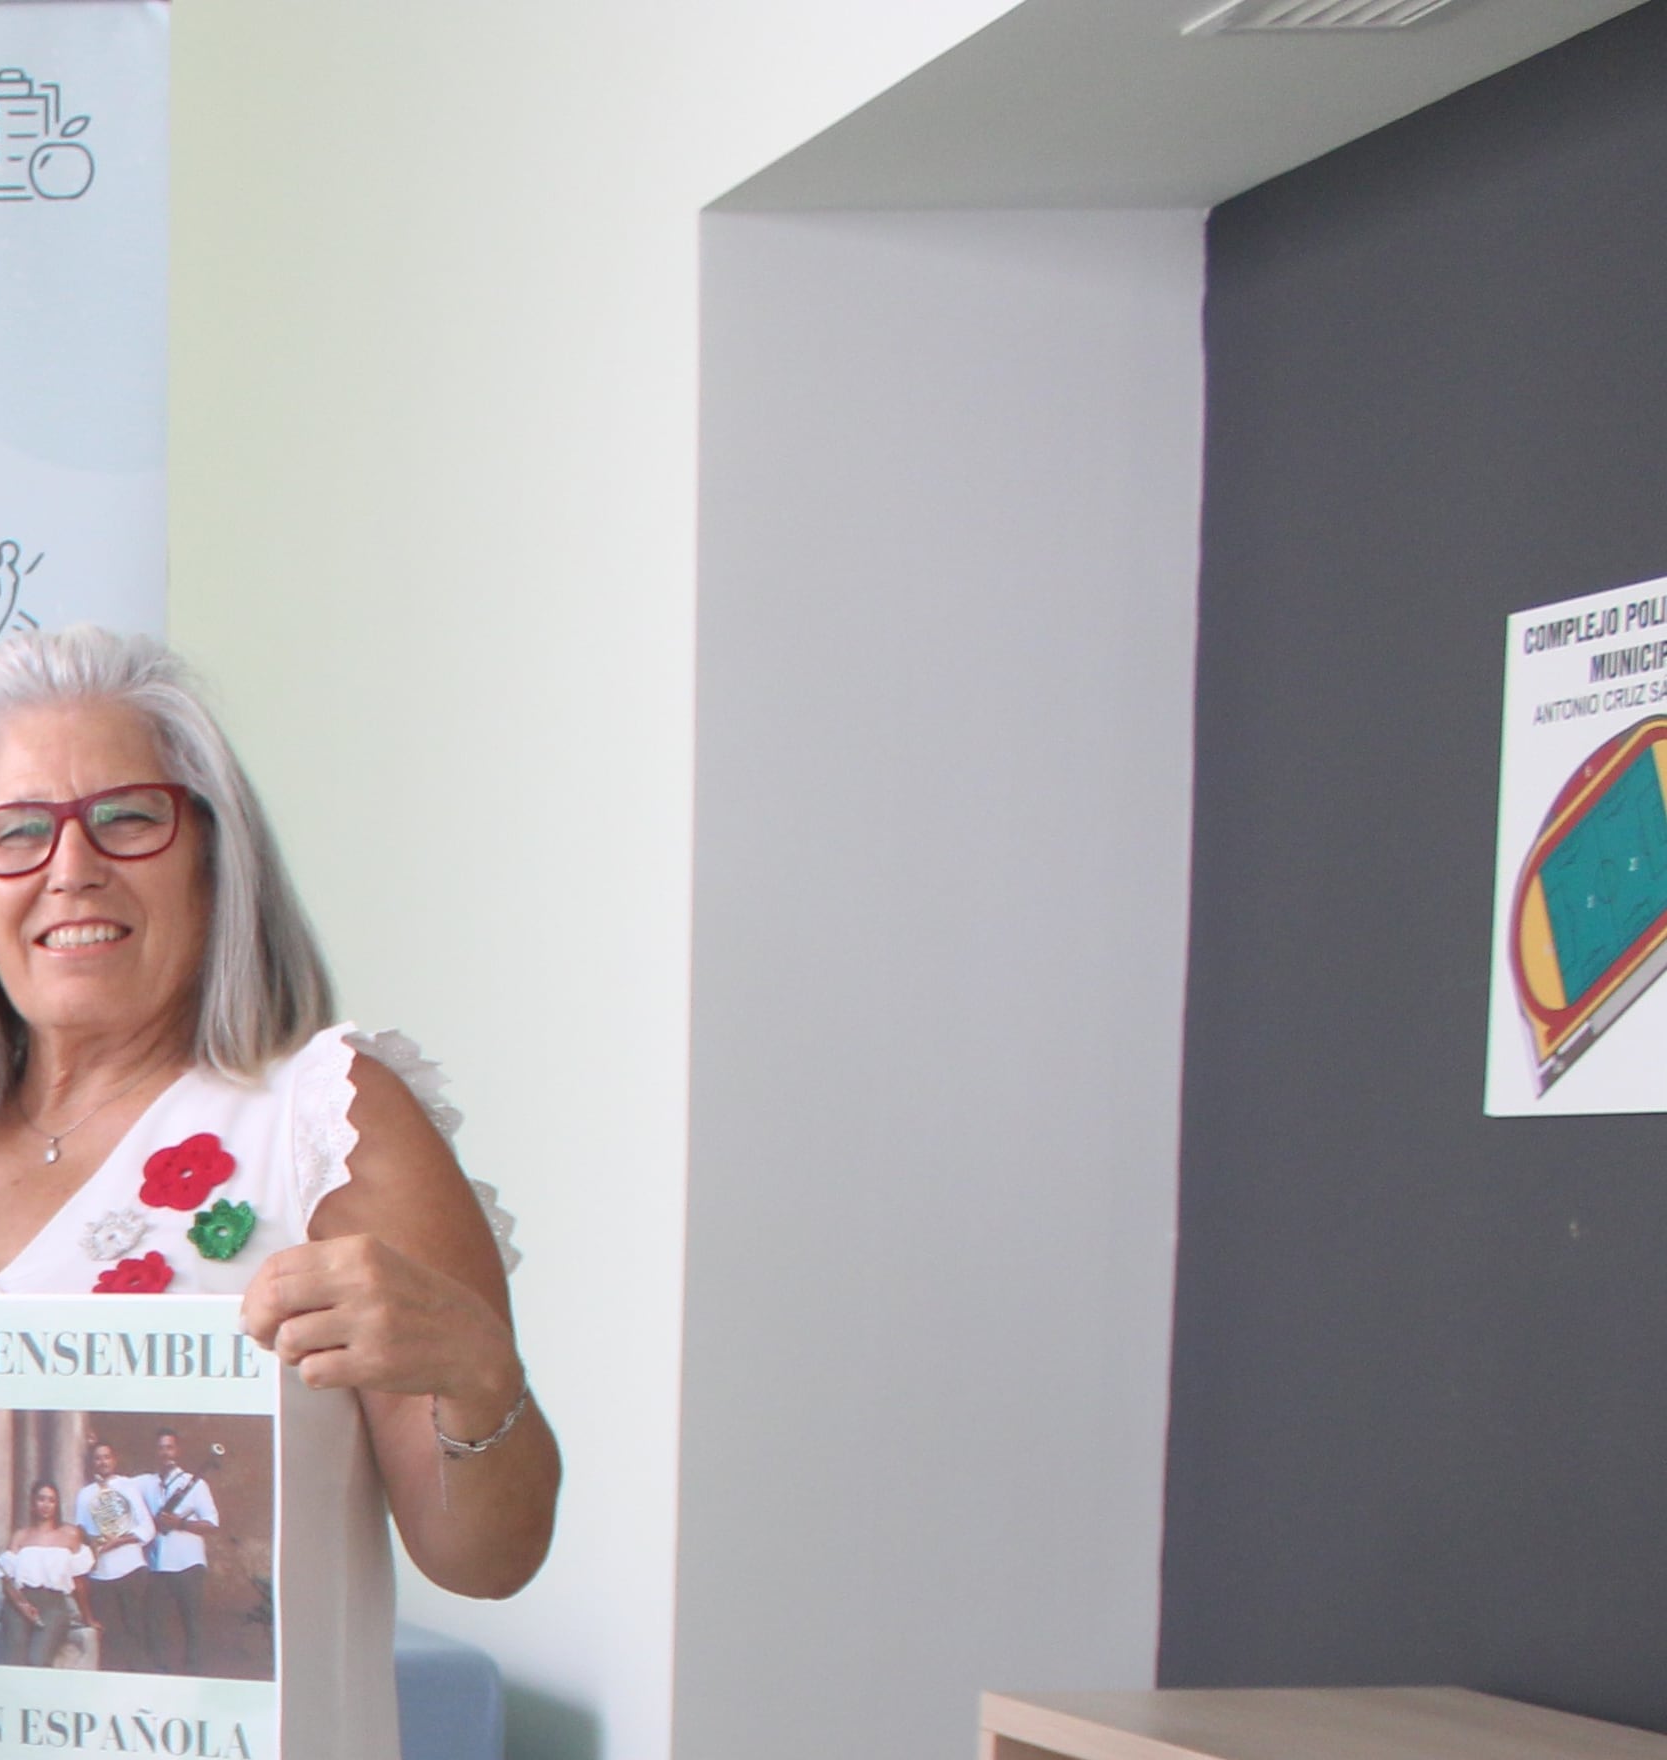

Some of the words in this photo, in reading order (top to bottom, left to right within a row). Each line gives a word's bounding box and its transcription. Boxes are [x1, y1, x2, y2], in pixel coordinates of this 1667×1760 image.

[1523, 606, 1621, 655] COMPLEJO
[1532, 693, 1599, 726] ANTONIO
[1603, 683, 1647, 712] CRUZ
[20, 1709, 251, 1758] ESPAÑOLA
